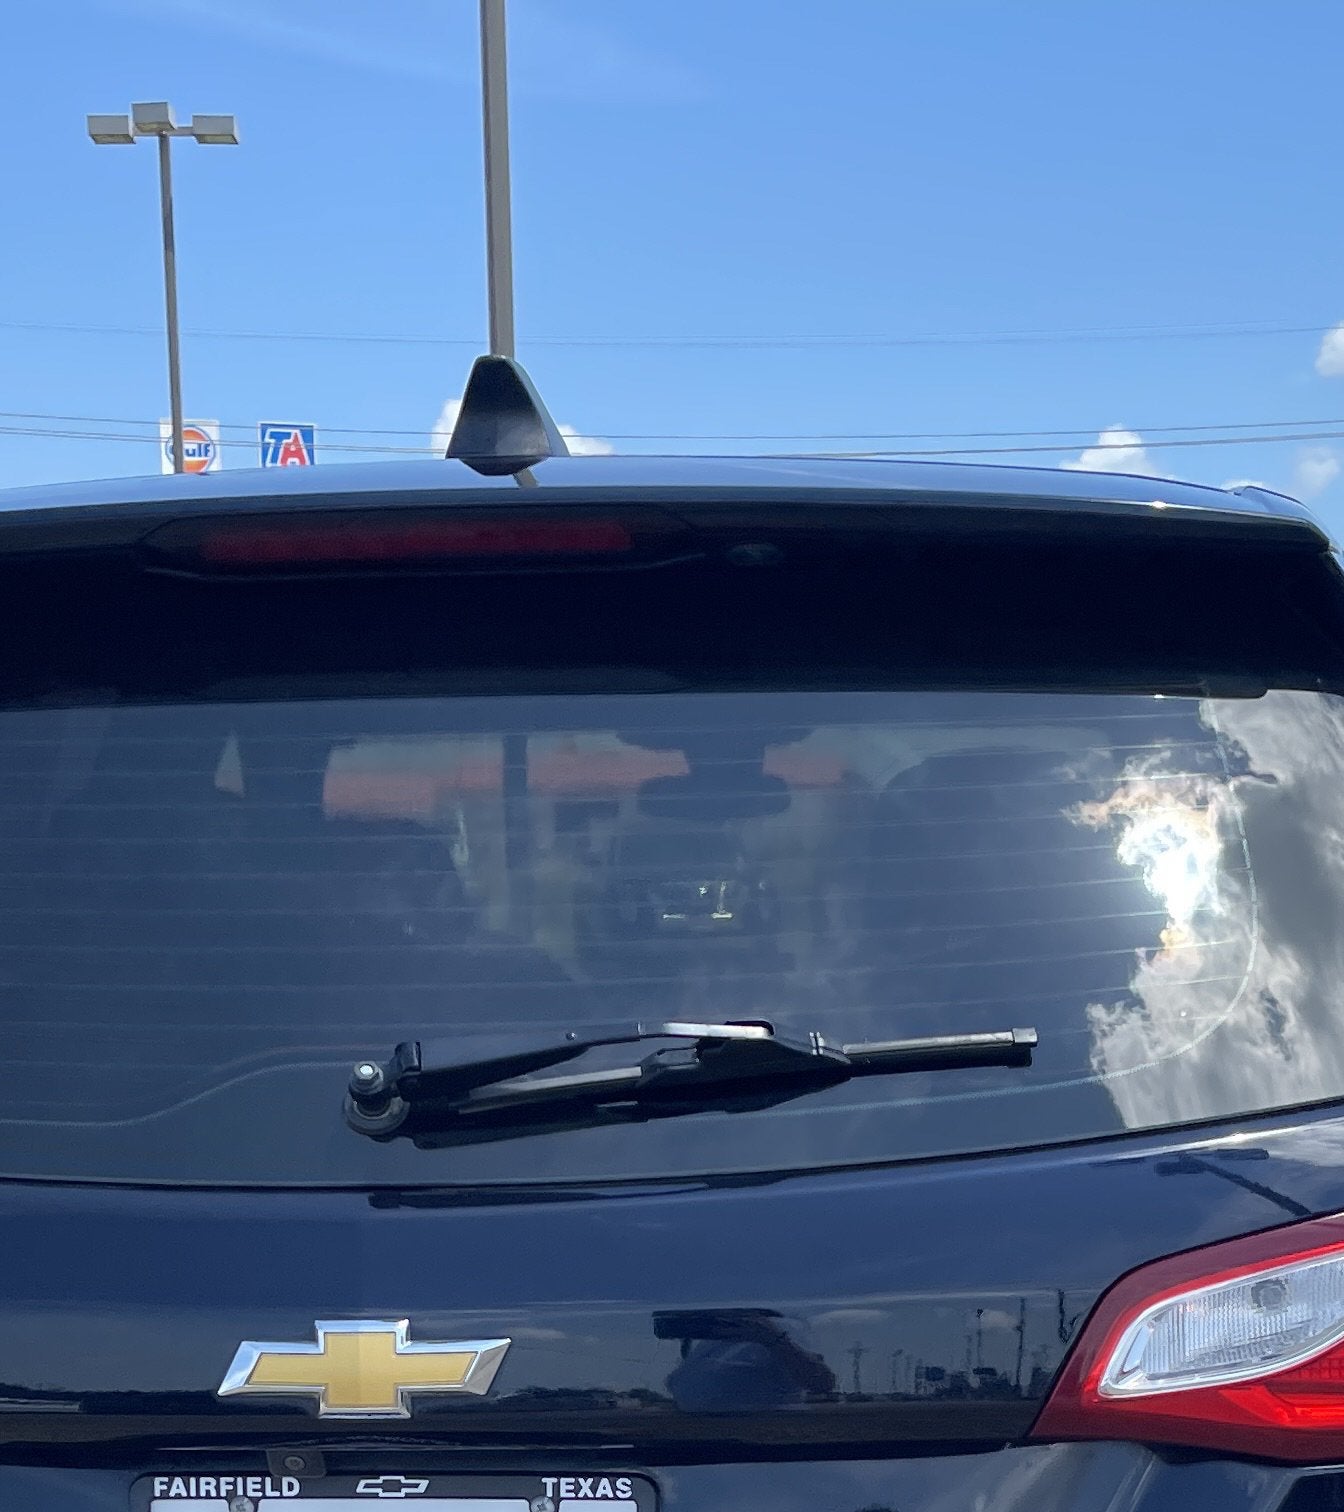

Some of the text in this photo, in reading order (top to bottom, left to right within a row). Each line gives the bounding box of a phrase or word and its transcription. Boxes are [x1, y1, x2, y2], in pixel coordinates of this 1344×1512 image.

[264, 429, 311, 467] TA
[153, 1476, 301, 1499] FAIRFIELD
[542, 1477, 633, 1499] TEXAS
